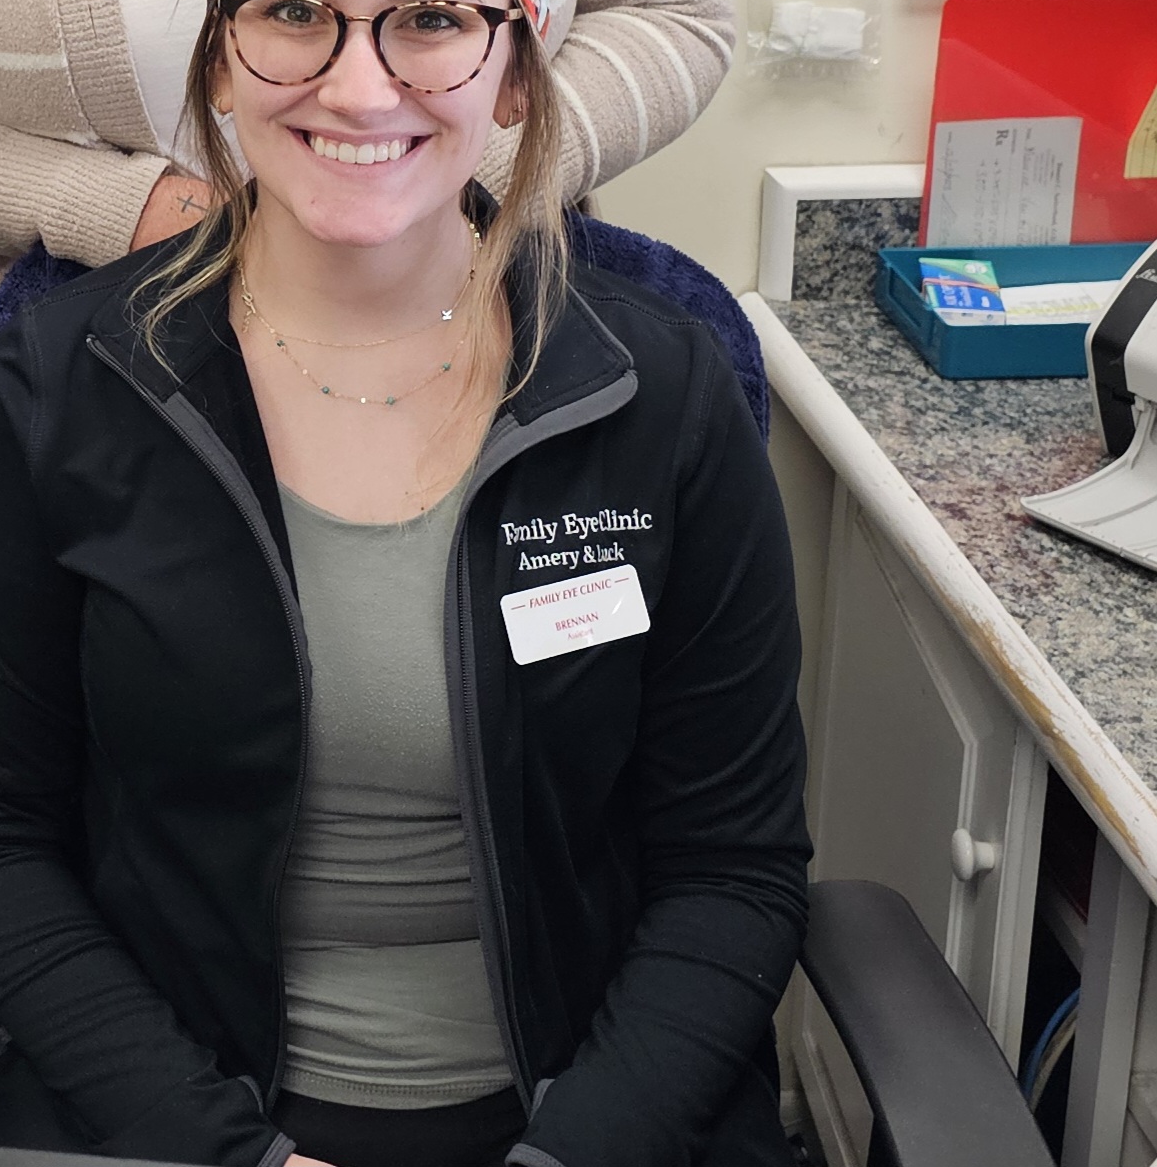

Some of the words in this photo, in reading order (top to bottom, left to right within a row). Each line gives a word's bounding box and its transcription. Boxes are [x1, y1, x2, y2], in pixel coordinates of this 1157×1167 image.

[518, 550, 580, 570] Amery
[583, 545, 596, 563] &
[529, 591, 561, 608] FAMILY
[563, 587, 579, 600] EYE
[580, 579, 612, 594] CLINIC
[555, 611, 599, 631] BRENNAN
